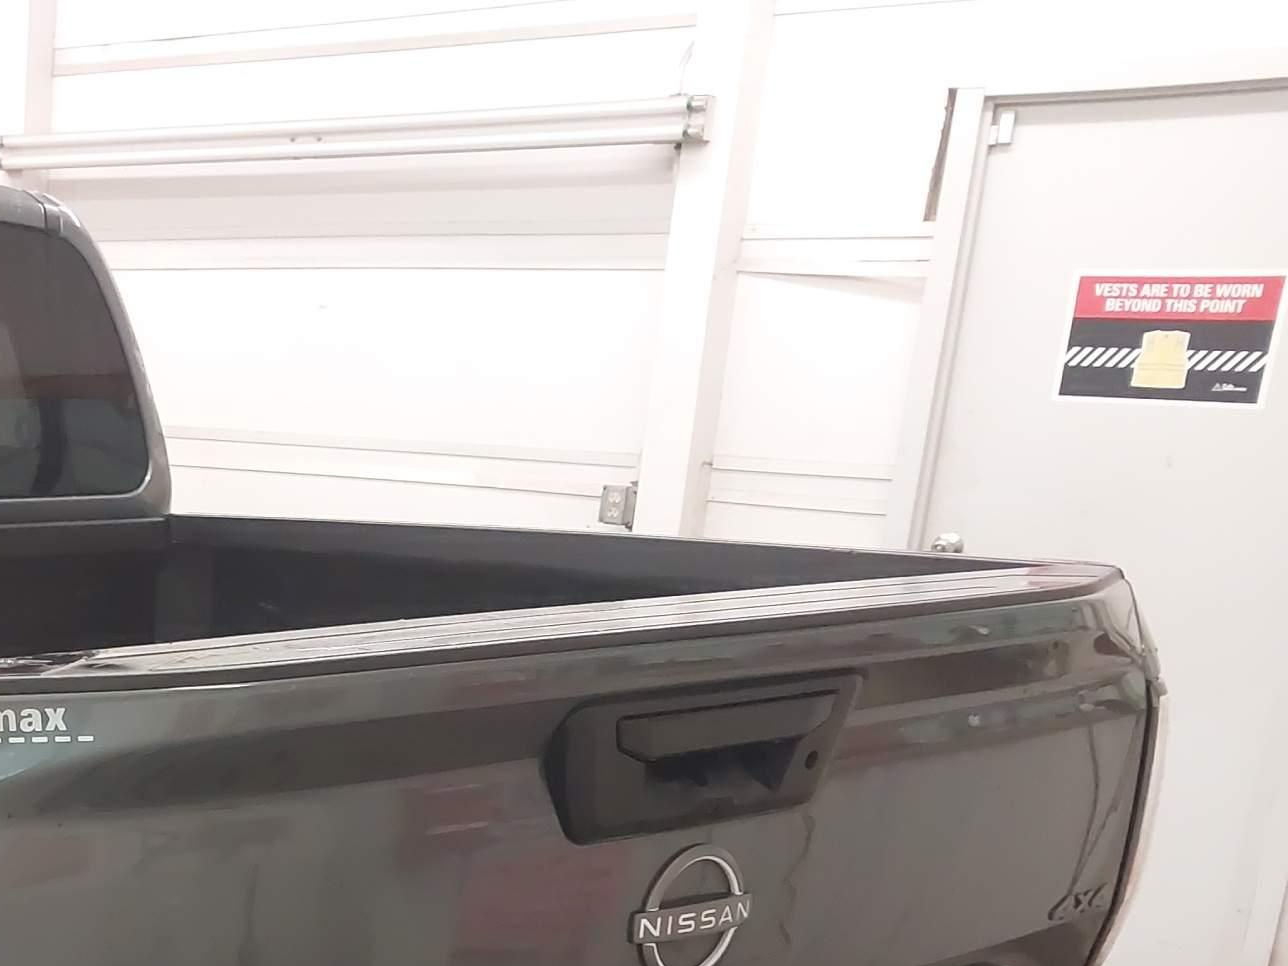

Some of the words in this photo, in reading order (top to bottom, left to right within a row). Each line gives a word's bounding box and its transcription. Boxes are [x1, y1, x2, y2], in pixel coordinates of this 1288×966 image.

[1094, 283, 1138, 297] VESTS
[1140, 283, 1169, 298] ARE
[1173, 284, 1190, 297] TO
[1193, 284, 1212, 298] BE
[1216, 284, 1264, 298] WORN
[1104, 298, 1161, 312] BEYOND
[1165, 299, 1196, 312] THIS
[1199, 300, 1247, 313] POINT
[639, 900, 750, 938] NISSAN
